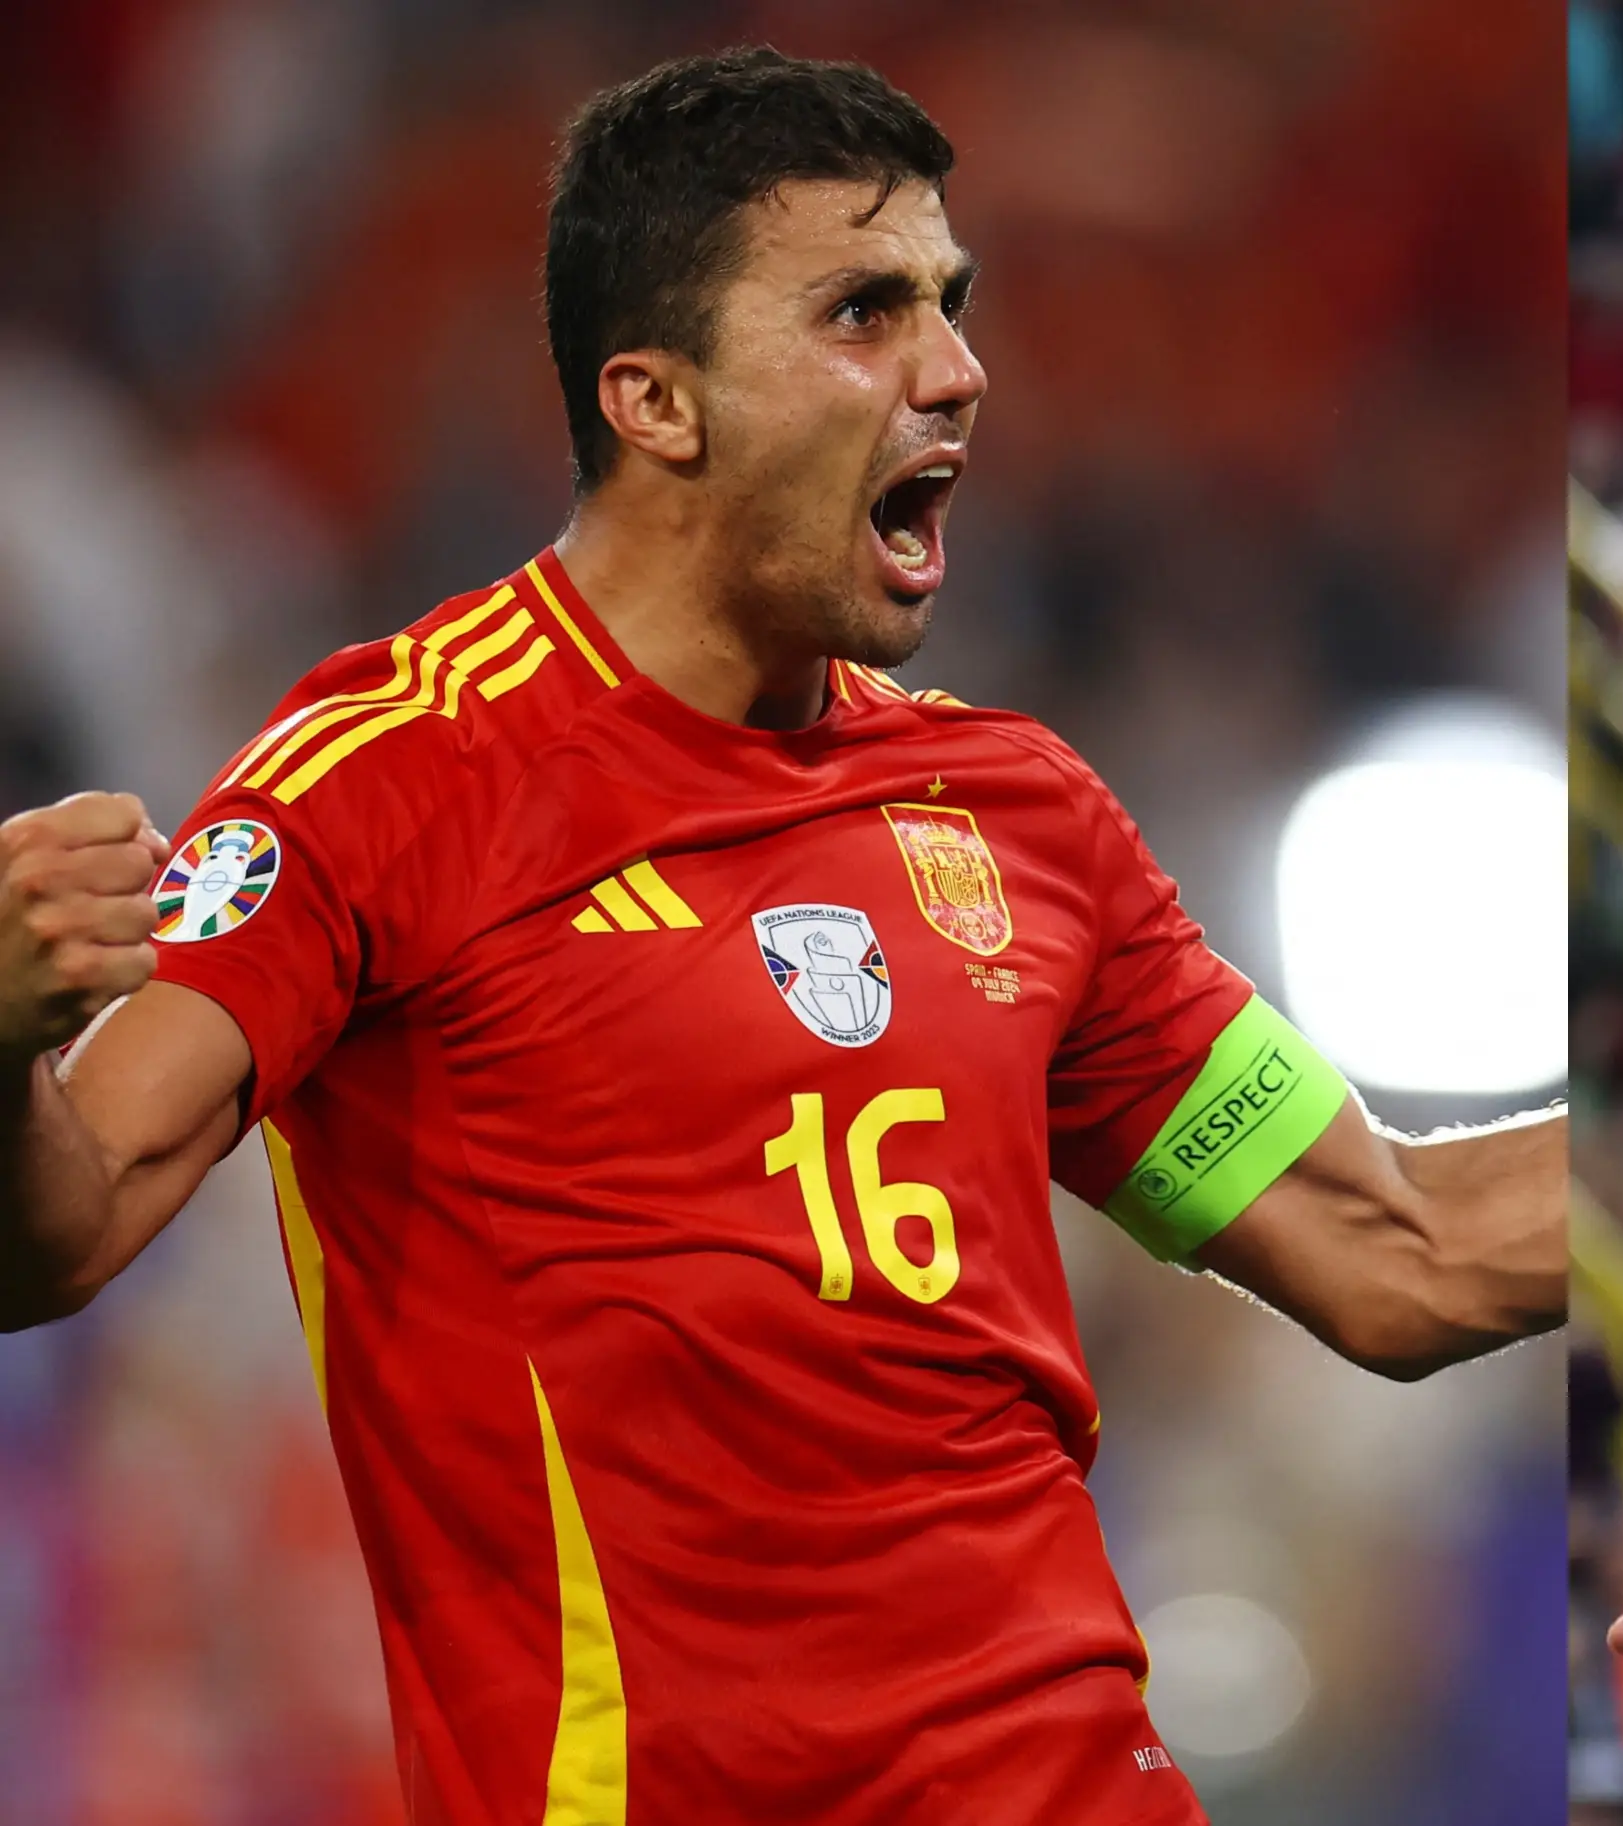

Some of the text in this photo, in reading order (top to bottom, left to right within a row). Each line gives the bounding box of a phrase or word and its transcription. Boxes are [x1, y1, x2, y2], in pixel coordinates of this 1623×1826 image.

[760, 909, 862, 926] UEFA NATIONS LEAGUE
[821, 1024, 880, 1042] WINNER 2023
[1172, 1047, 1293, 1170] RESPECT
[763, 1087, 961, 1304] 16
